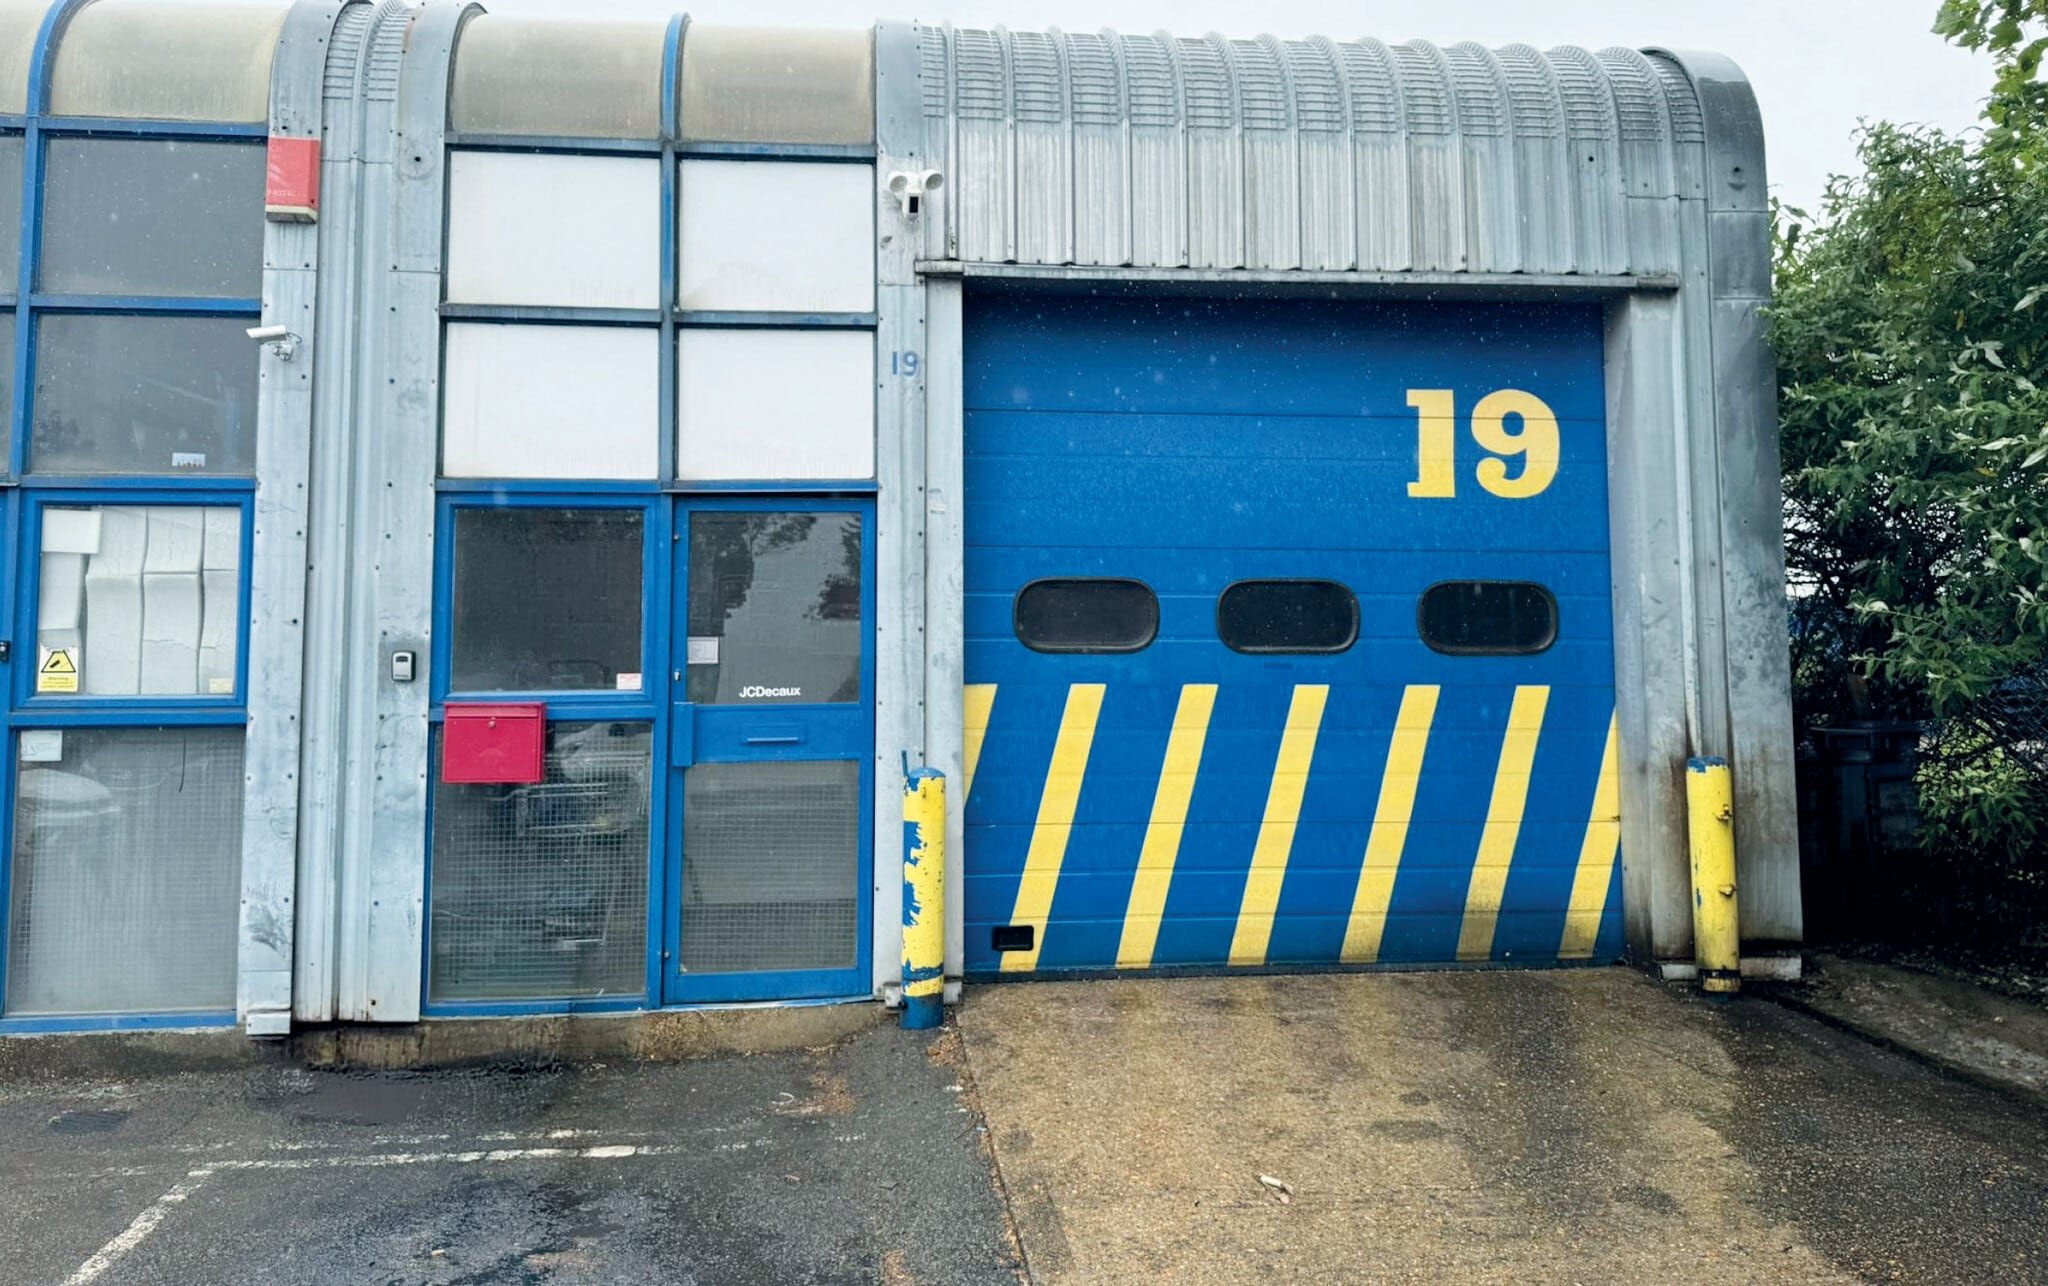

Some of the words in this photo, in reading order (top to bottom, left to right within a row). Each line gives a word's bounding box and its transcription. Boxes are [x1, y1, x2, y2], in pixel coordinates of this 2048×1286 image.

[892, 350, 918, 377] 19
[1406, 388, 1561, 499] 19
[738, 686, 801, 698] JCDecaux
